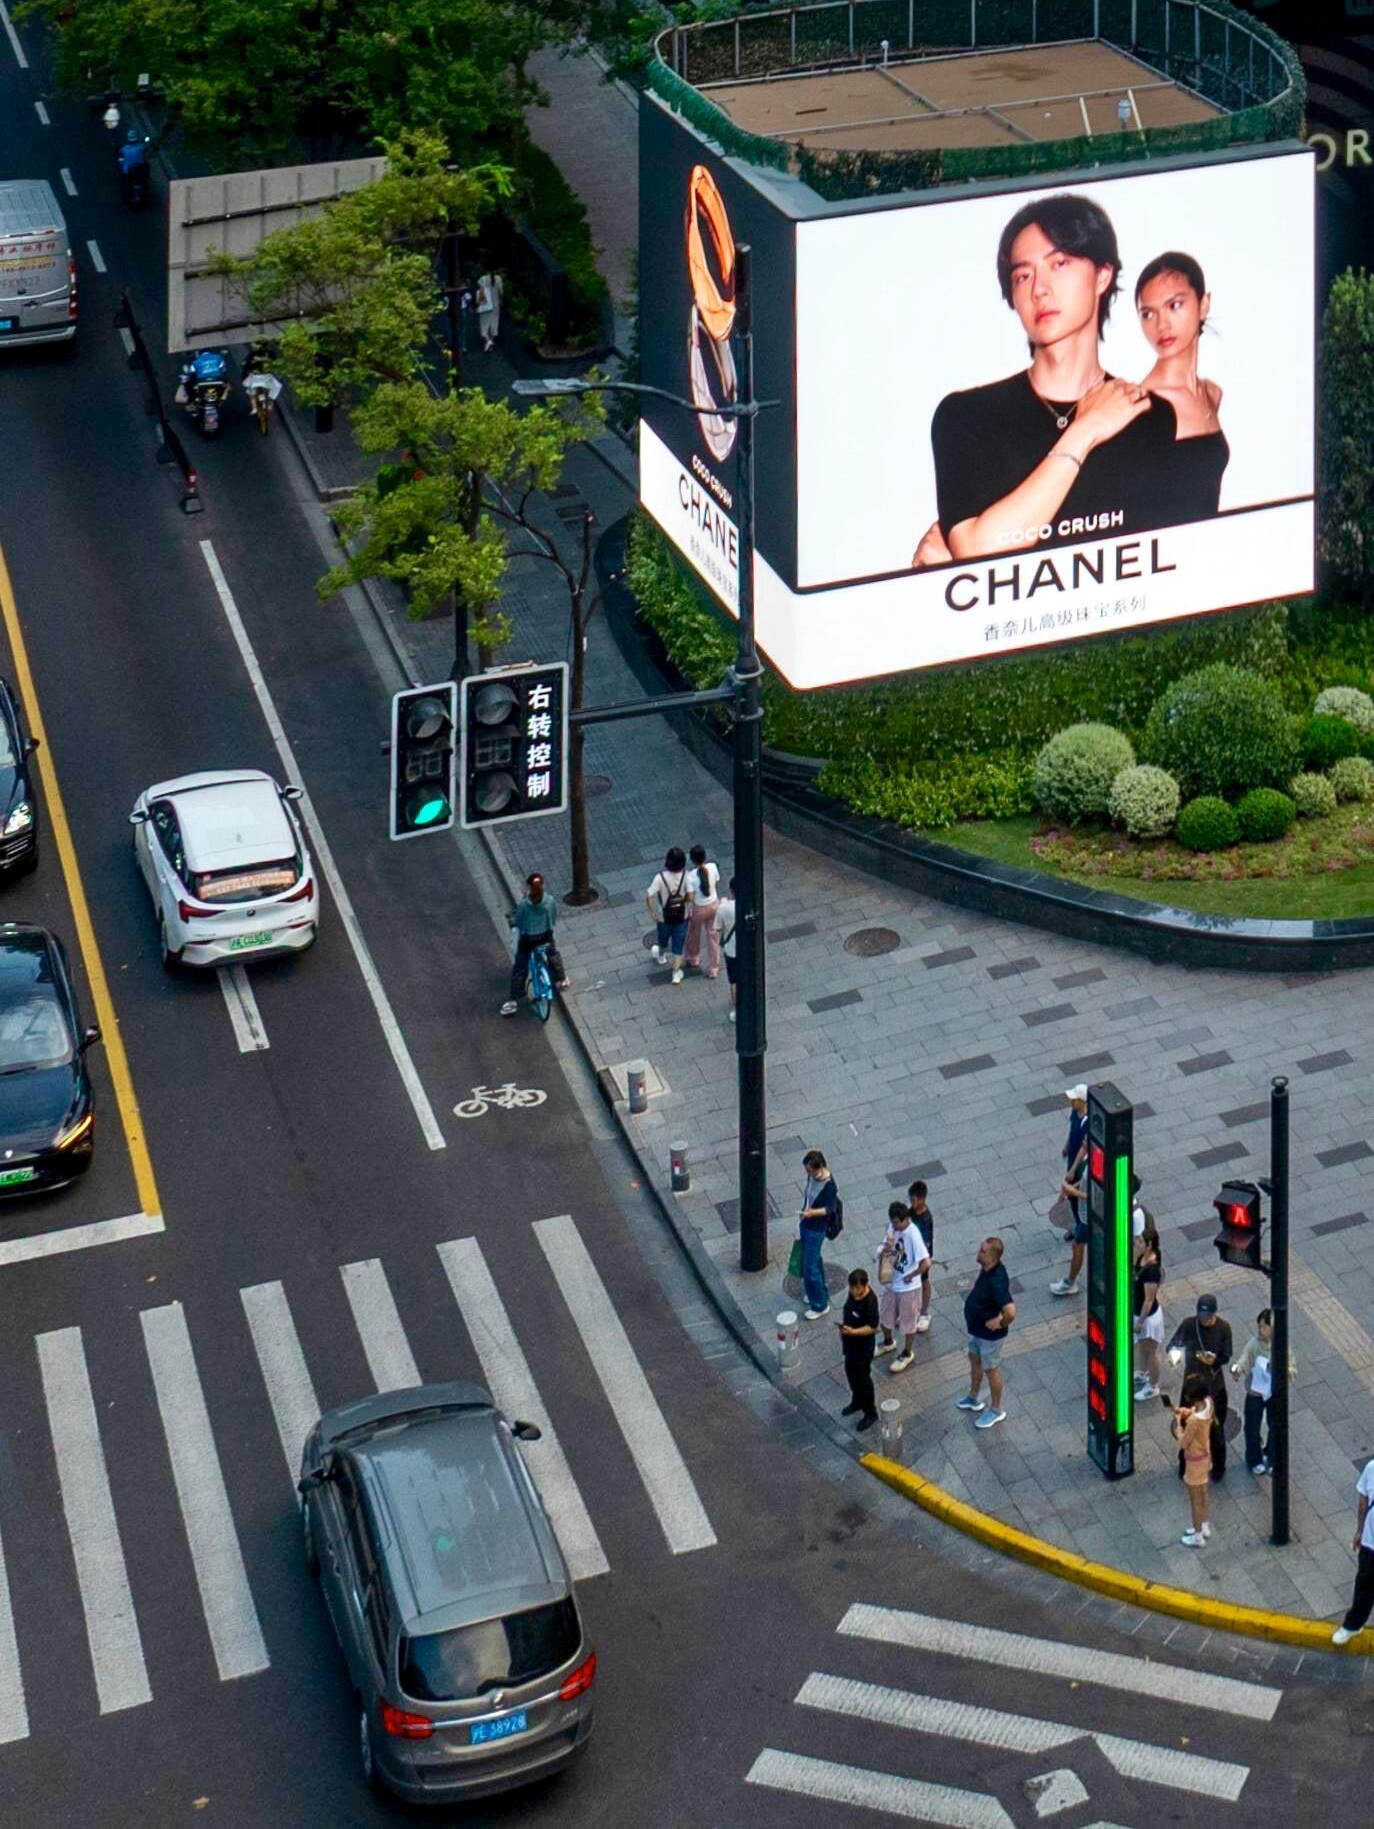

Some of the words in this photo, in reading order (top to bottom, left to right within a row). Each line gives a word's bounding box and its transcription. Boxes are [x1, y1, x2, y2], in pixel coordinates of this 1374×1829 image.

[678, 473, 738, 571] CHANE
[1058, 509, 1124, 537] CRUSH
[944, 537, 1177, 612] CHANEL
[526, 683, 553, 799] 右转控制
